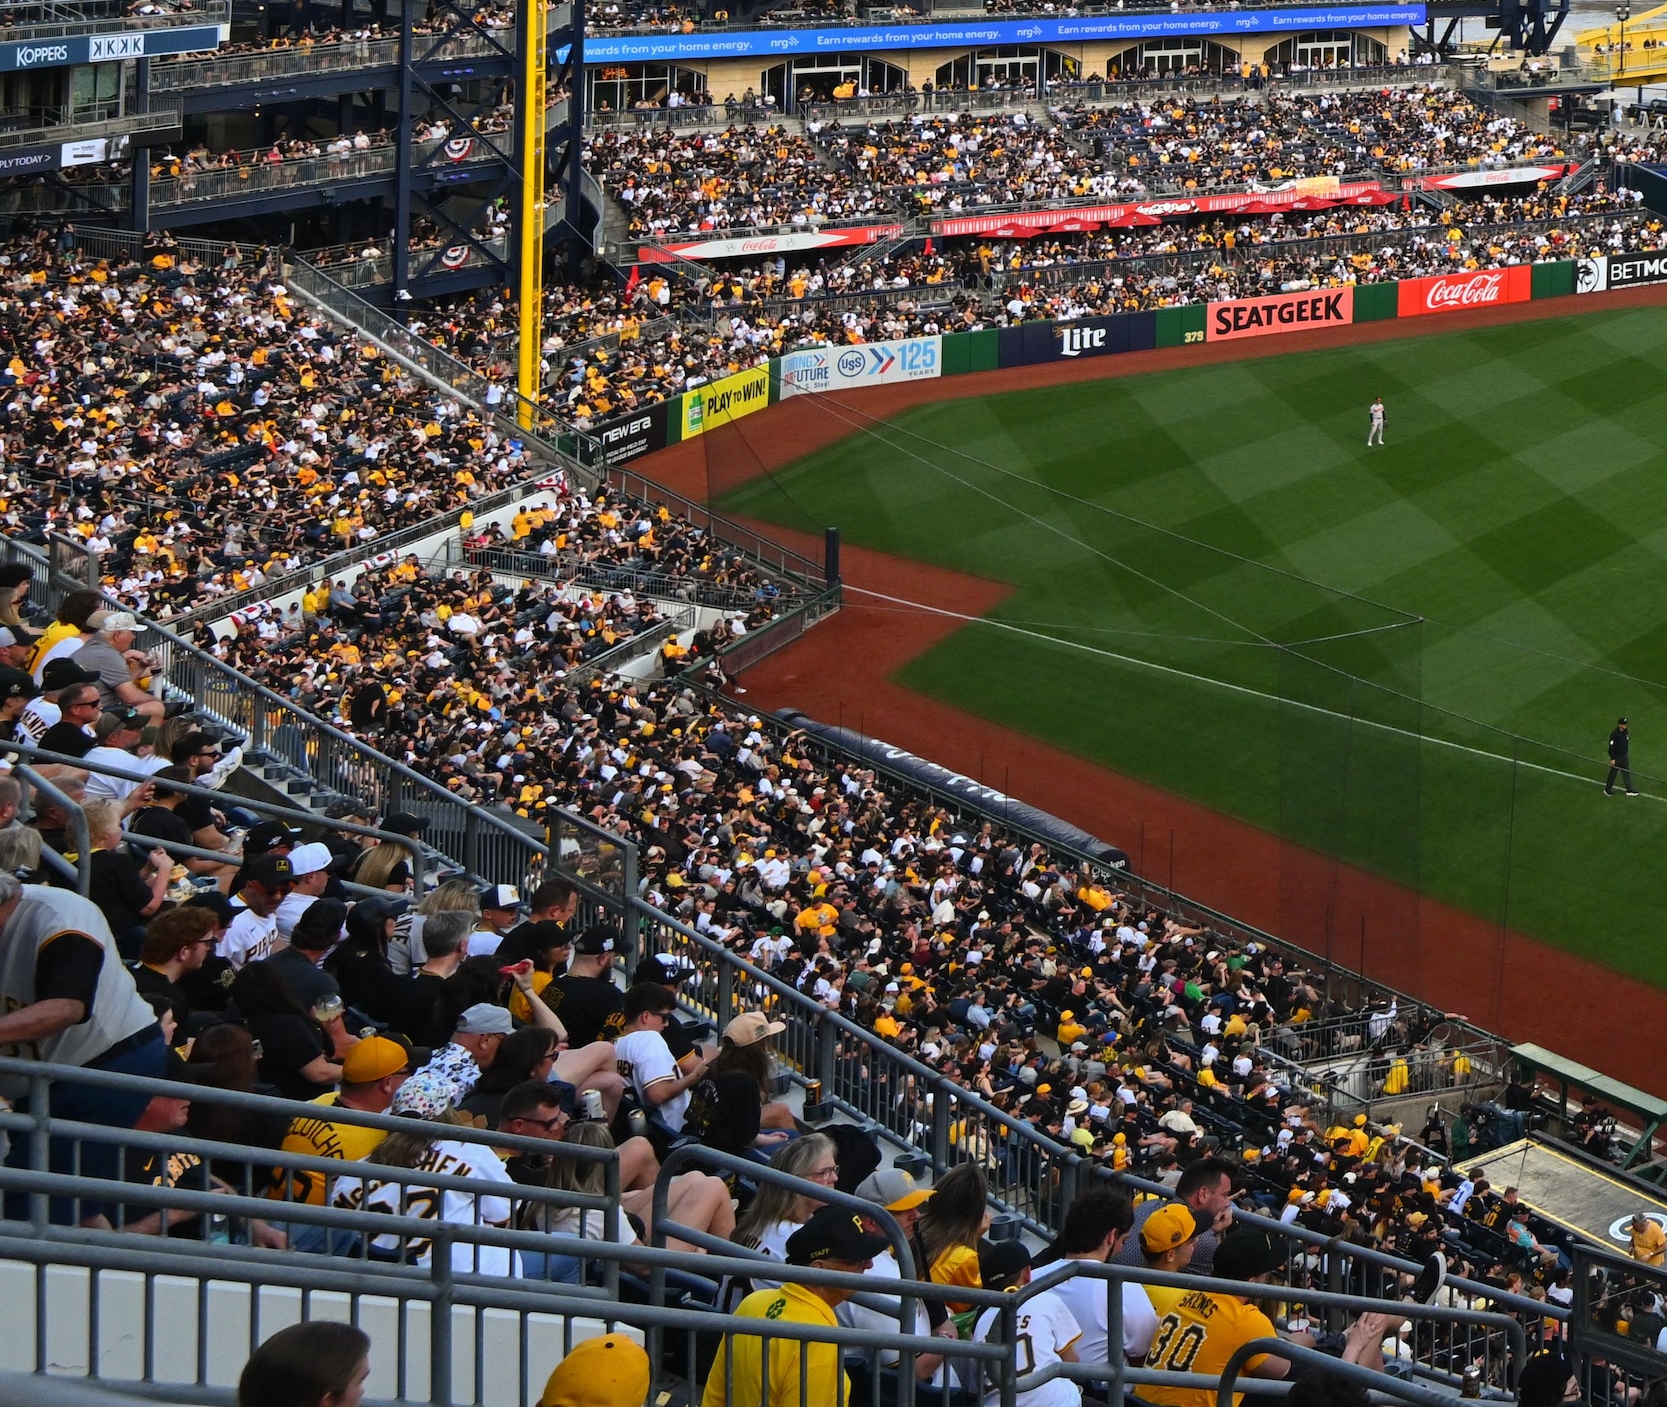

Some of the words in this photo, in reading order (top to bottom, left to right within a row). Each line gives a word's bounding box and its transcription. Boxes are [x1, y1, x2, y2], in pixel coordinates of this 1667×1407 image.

[770, 39, 788, 50] nrg
[817, 35, 839, 46] Earn
[842, 34, 883, 44] rewards
[885, 32, 908, 42] from
[910, 31, 933, 43] your
[935, 30, 963, 41] home
[965, 28, 1001, 42] energy.
[16, 45, 68, 67] KOPPERS
[1426, 273, 1504, 309] Coca-Cola
[1215, 292, 1345, 335] SEATGEEK
[1061, 326, 1106, 357] Lite
[1184, 331, 1204, 343] 379
[898, 340, 936, 370] 125
[908, 368, 934, 377] YEARS
[708, 395, 732, 417] PLAY
[733, 392, 742, 402] TO
[742, 377, 766, 402] WIN!
[603, 425, 628, 443] NEW
[629, 416, 651, 435] ERA
[810, 1247, 830, 1259] STAFF
[1178, 1290, 1218, 1320] SKENES
[1144, 1312, 1208, 1372] 30
